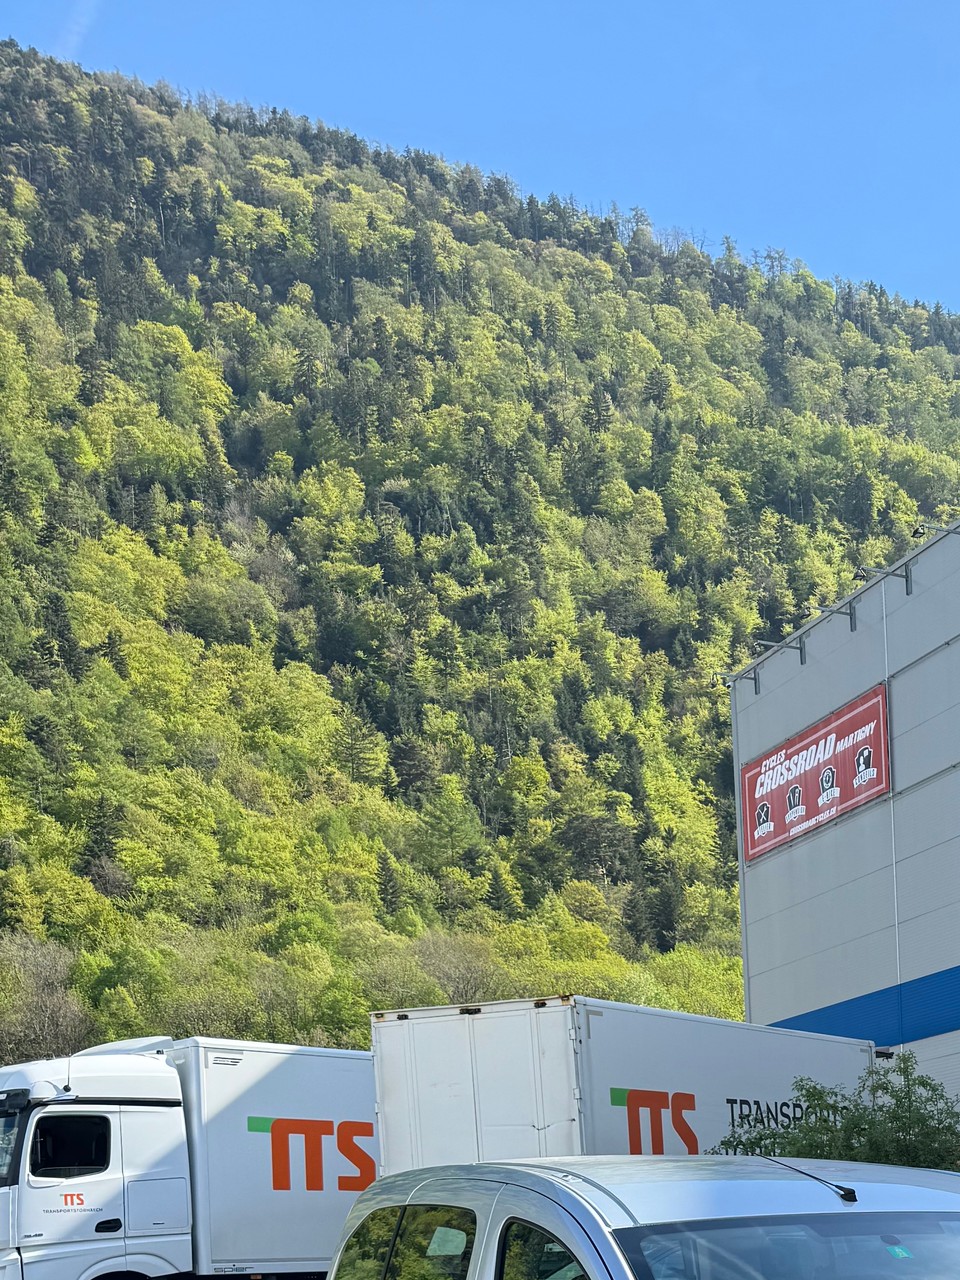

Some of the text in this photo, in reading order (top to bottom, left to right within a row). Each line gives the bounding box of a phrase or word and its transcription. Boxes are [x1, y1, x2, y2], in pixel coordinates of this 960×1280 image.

[755, 719, 877, 798] CROSSROAD MARTIGNY
[761, 749, 786, 773] CYCLES
[247, 1116, 376, 1191] TTS
[610, 1088, 698, 1155] TTS
[59, 1193, 85, 1206] TTS
